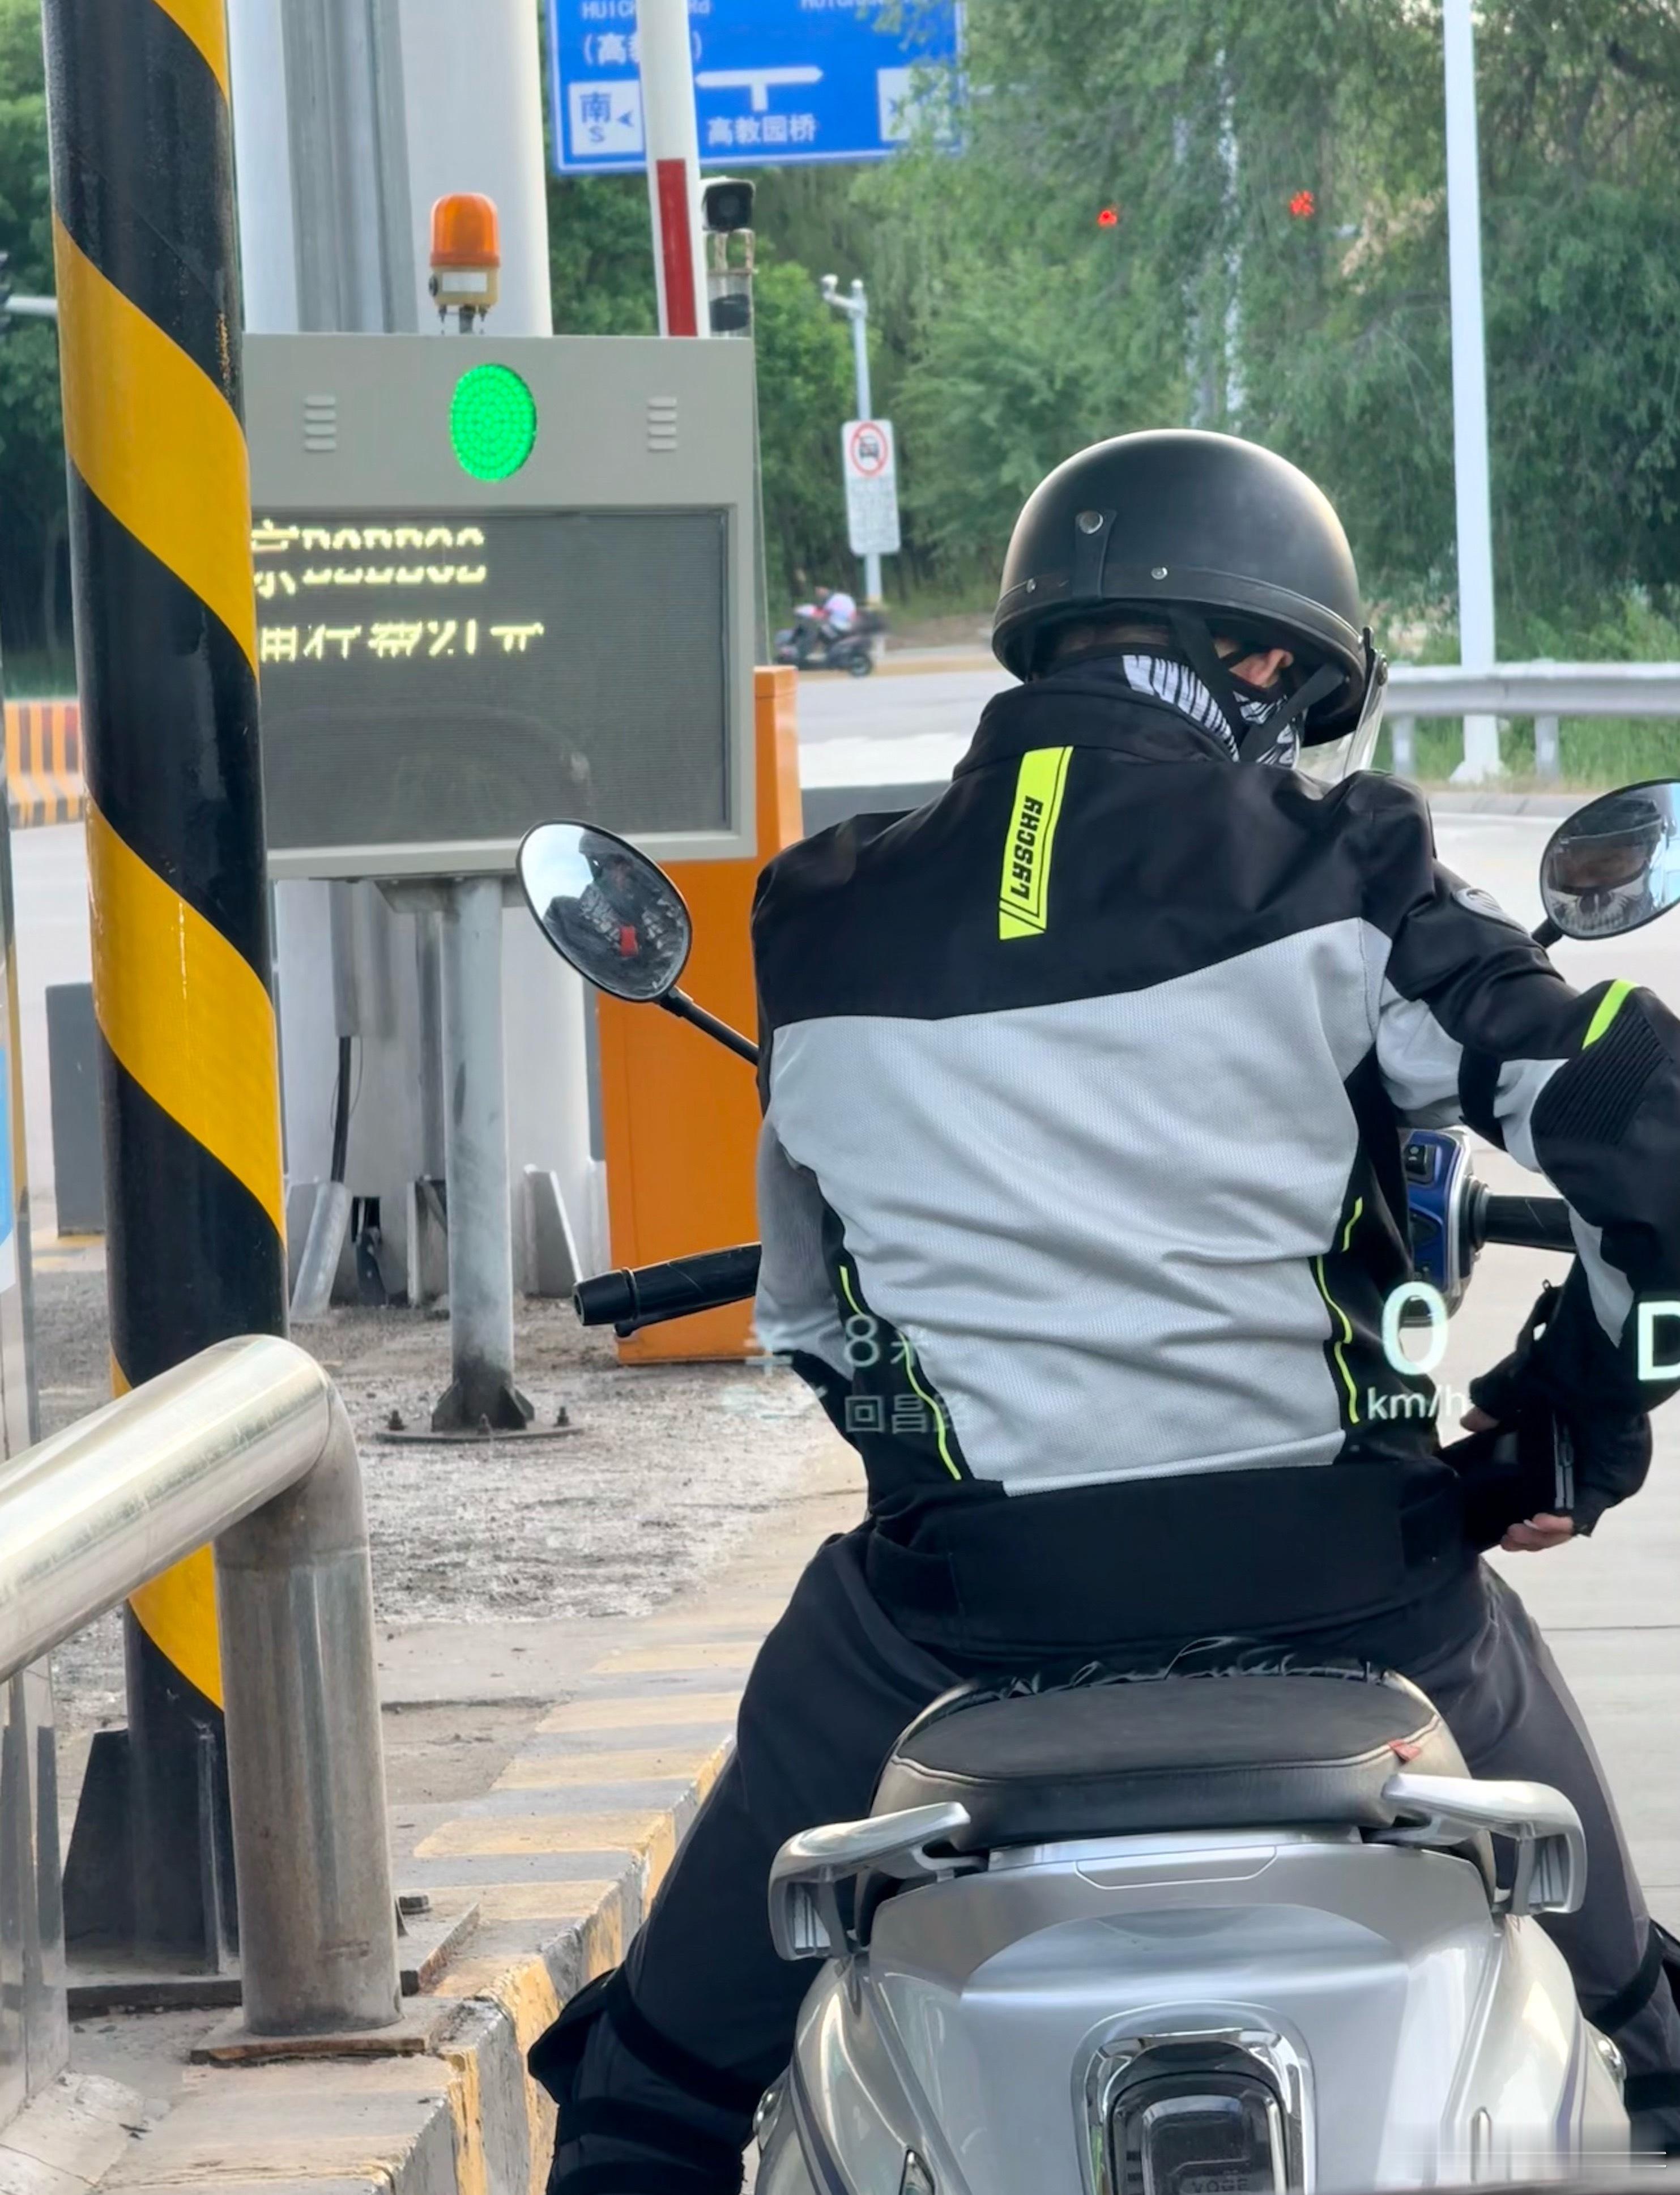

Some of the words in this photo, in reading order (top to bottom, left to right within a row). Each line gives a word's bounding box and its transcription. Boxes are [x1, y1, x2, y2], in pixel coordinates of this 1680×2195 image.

[579, 92, 612, 123] 南
[589, 125, 606, 143] S
[707, 113, 816, 146] 高教园桥
[1010, 795, 1044, 901] LYSCHY
[1381, 1281, 1448, 1375] 0
[1637, 1300, 1680, 1382] D
[1367, 1384, 1470, 1420] km/h
